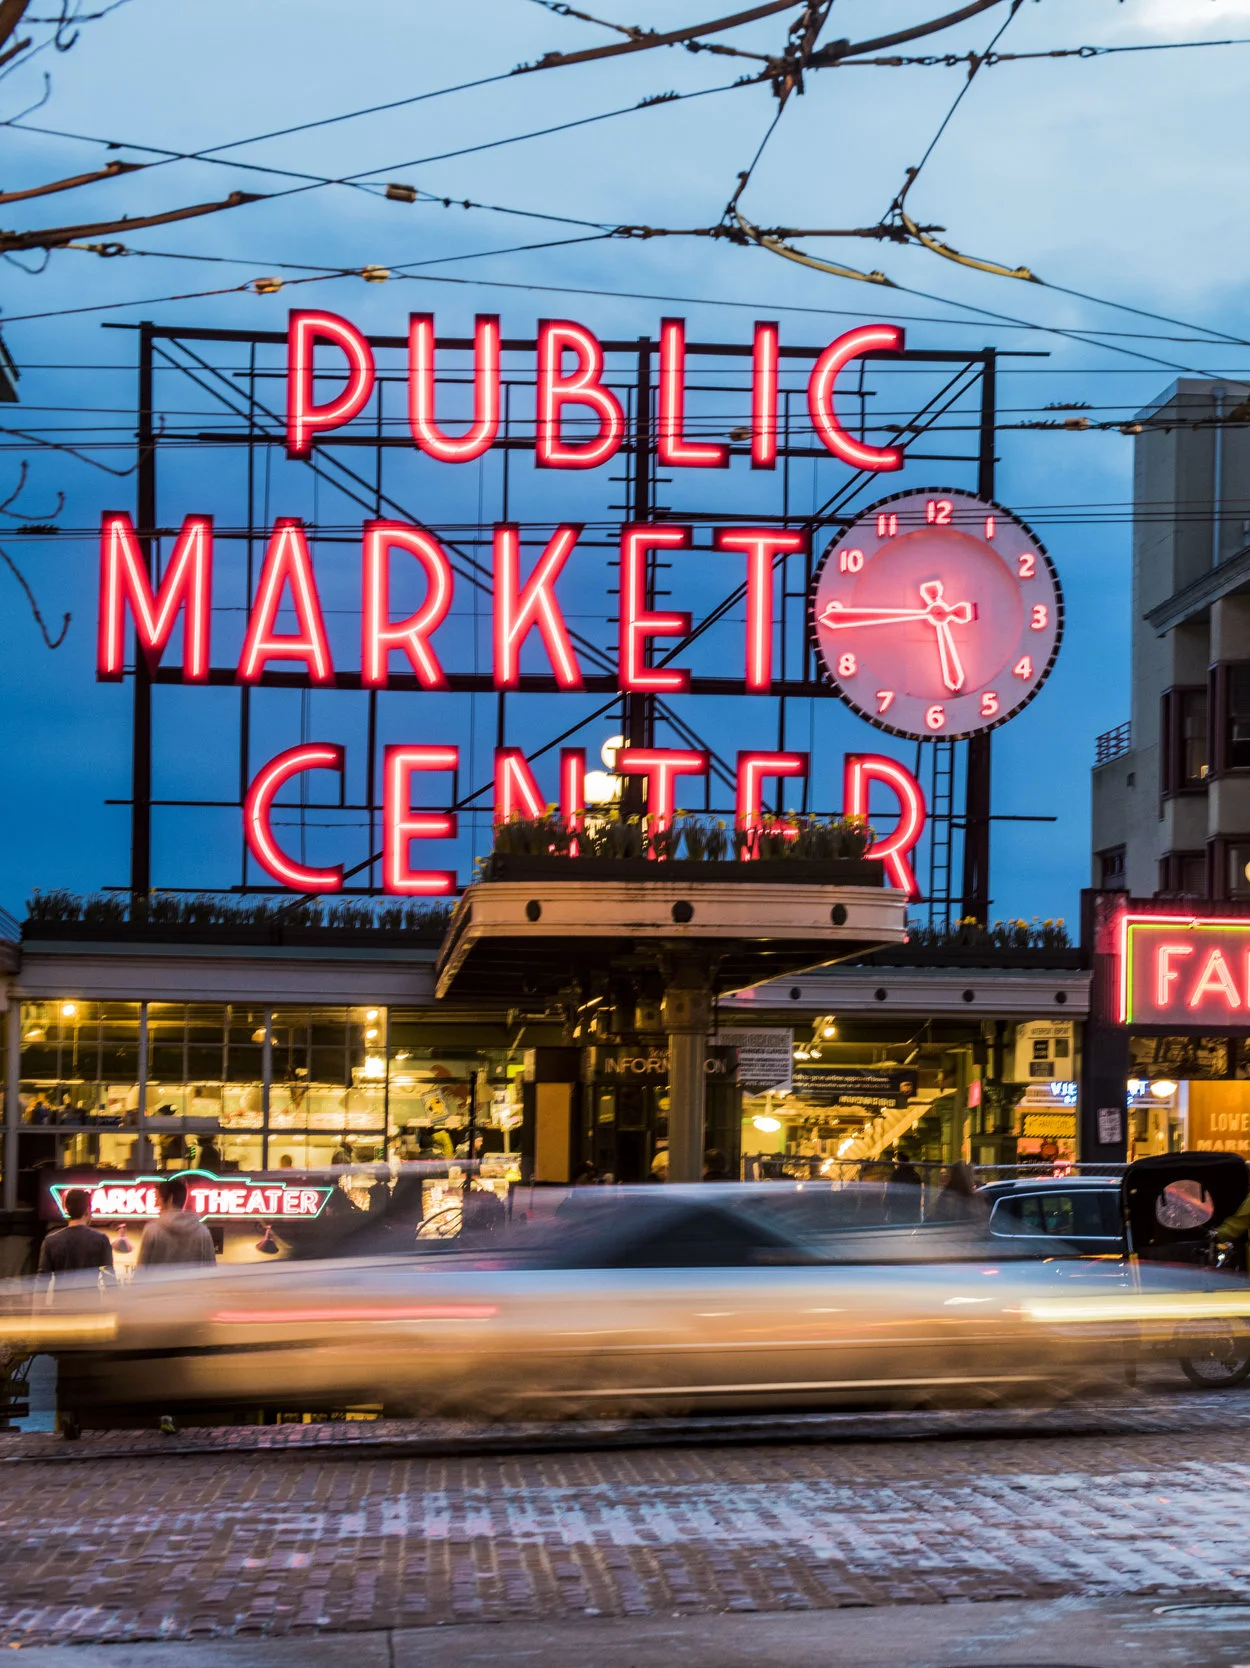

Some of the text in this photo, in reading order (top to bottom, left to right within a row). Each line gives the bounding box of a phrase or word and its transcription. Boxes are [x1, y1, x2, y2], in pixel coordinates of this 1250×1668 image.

[286, 308, 907, 473] PUBLIC
[926, 499, 954, 525] 12
[876, 513, 898, 537] 11
[984, 515, 995, 539] 1
[839, 549, 864, 573] 10
[1018, 553, 1036, 578] 2
[95, 509, 806, 694] MARKET
[1030, 604, 1048, 630] 3
[838, 653, 857, 677] 8
[1012, 655, 1033, 680] 4
[876, 691, 895, 713] 7
[980, 692, 999, 717] 5
[925, 705, 946, 730] 6
[243, 742, 928, 903] CENTER
[190, 1189, 318, 1214] THEATER
